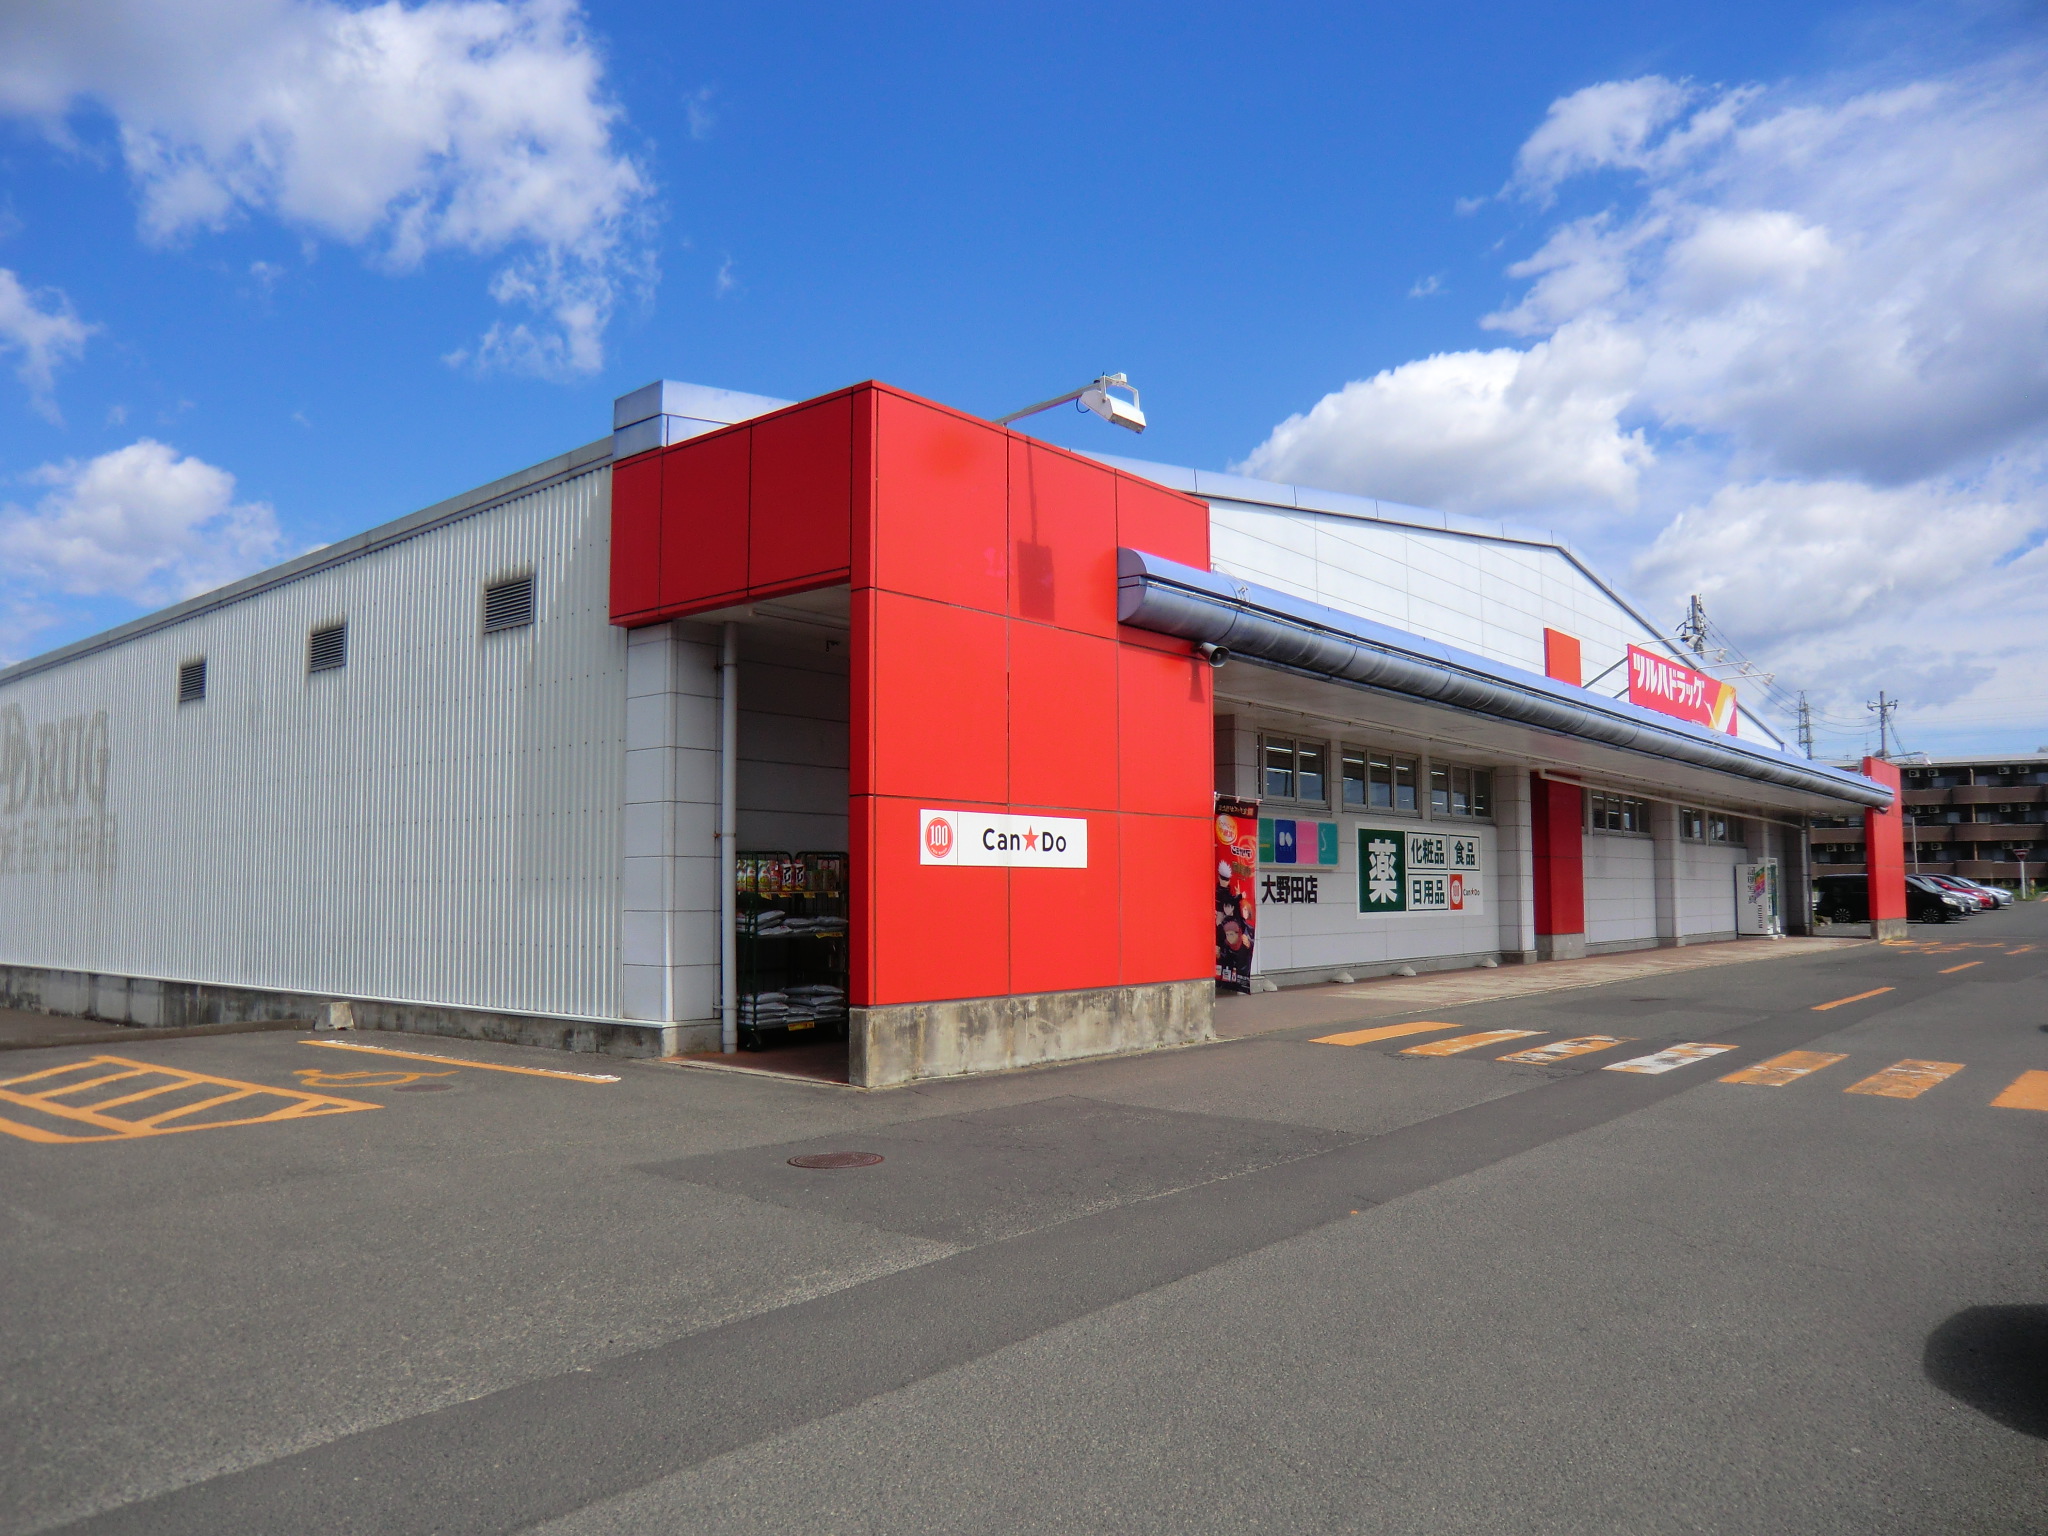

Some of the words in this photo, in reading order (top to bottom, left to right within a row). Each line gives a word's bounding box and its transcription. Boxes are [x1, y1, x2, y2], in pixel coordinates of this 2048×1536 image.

[1633, 652, 1705, 709] ツルハドラッグ
[930, 825, 948, 847] 100
[1411, 838, 1445, 865] 化粧品
[1453, 841, 1476, 866] 食品
[1368, 838, 1398, 904] 薬
[1261, 874, 1318, 904] 大野田店
[1412, 879, 1445, 905] 日用品
